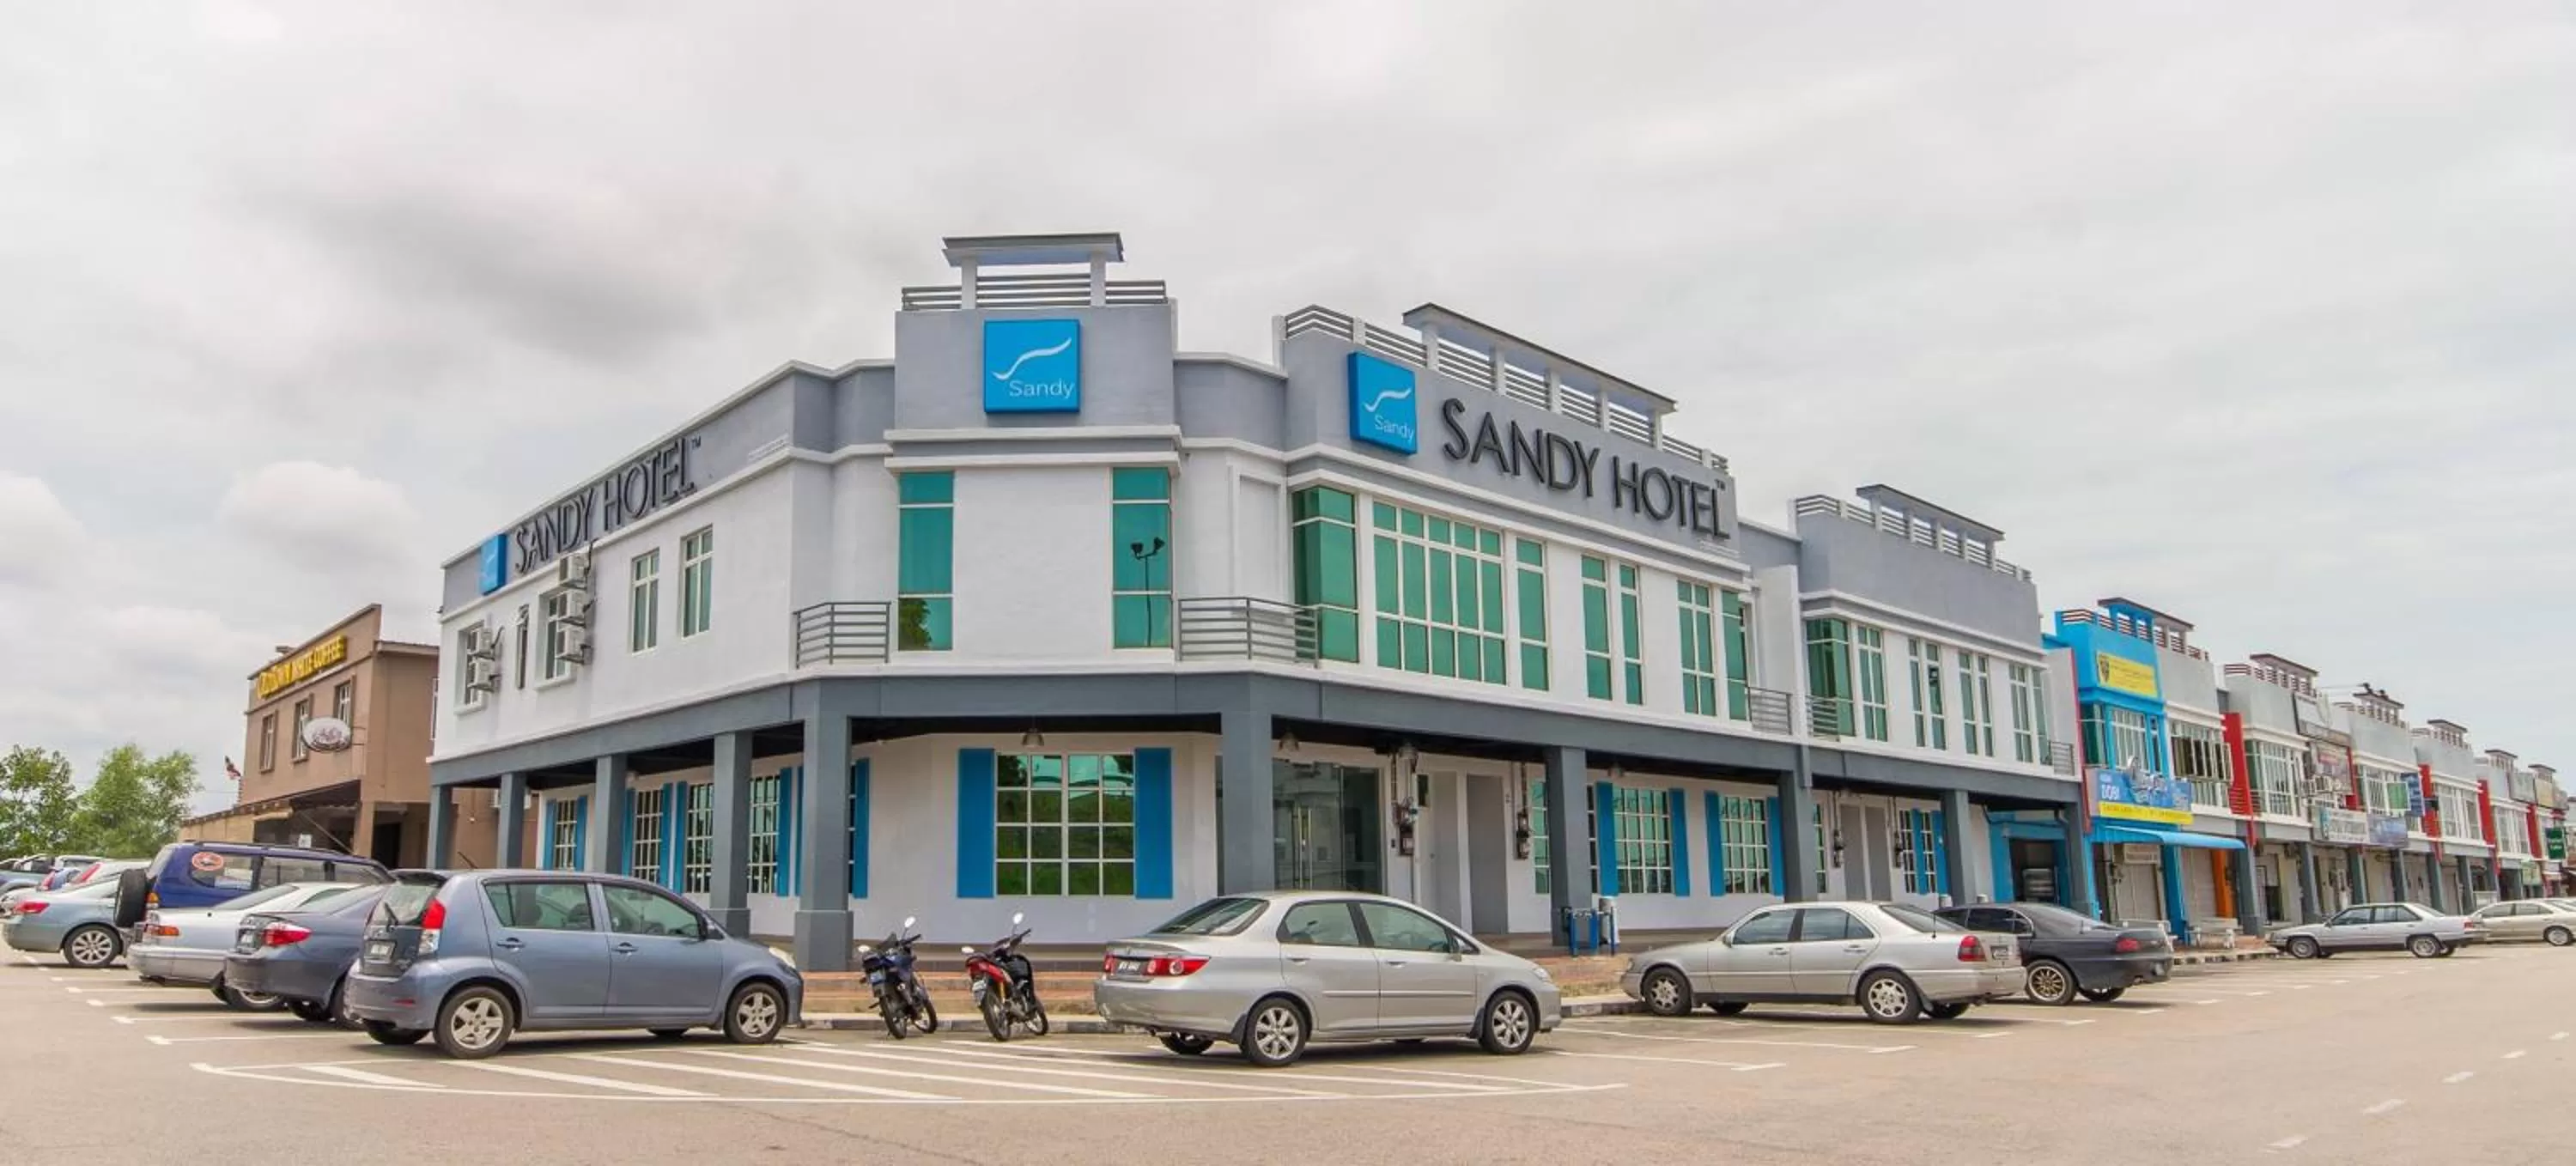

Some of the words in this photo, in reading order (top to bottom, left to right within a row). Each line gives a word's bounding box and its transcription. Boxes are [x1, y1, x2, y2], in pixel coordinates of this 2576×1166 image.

[1009, 378, 1075, 399] Sandy
[1374, 414, 1414, 444] Sandy
[515, 487, 595, 574] SANDY
[604, 436, 697, 531] HOTEL
[1442, 398, 1601, 498] SANDY
[1611, 455, 1731, 541] HOTEL
